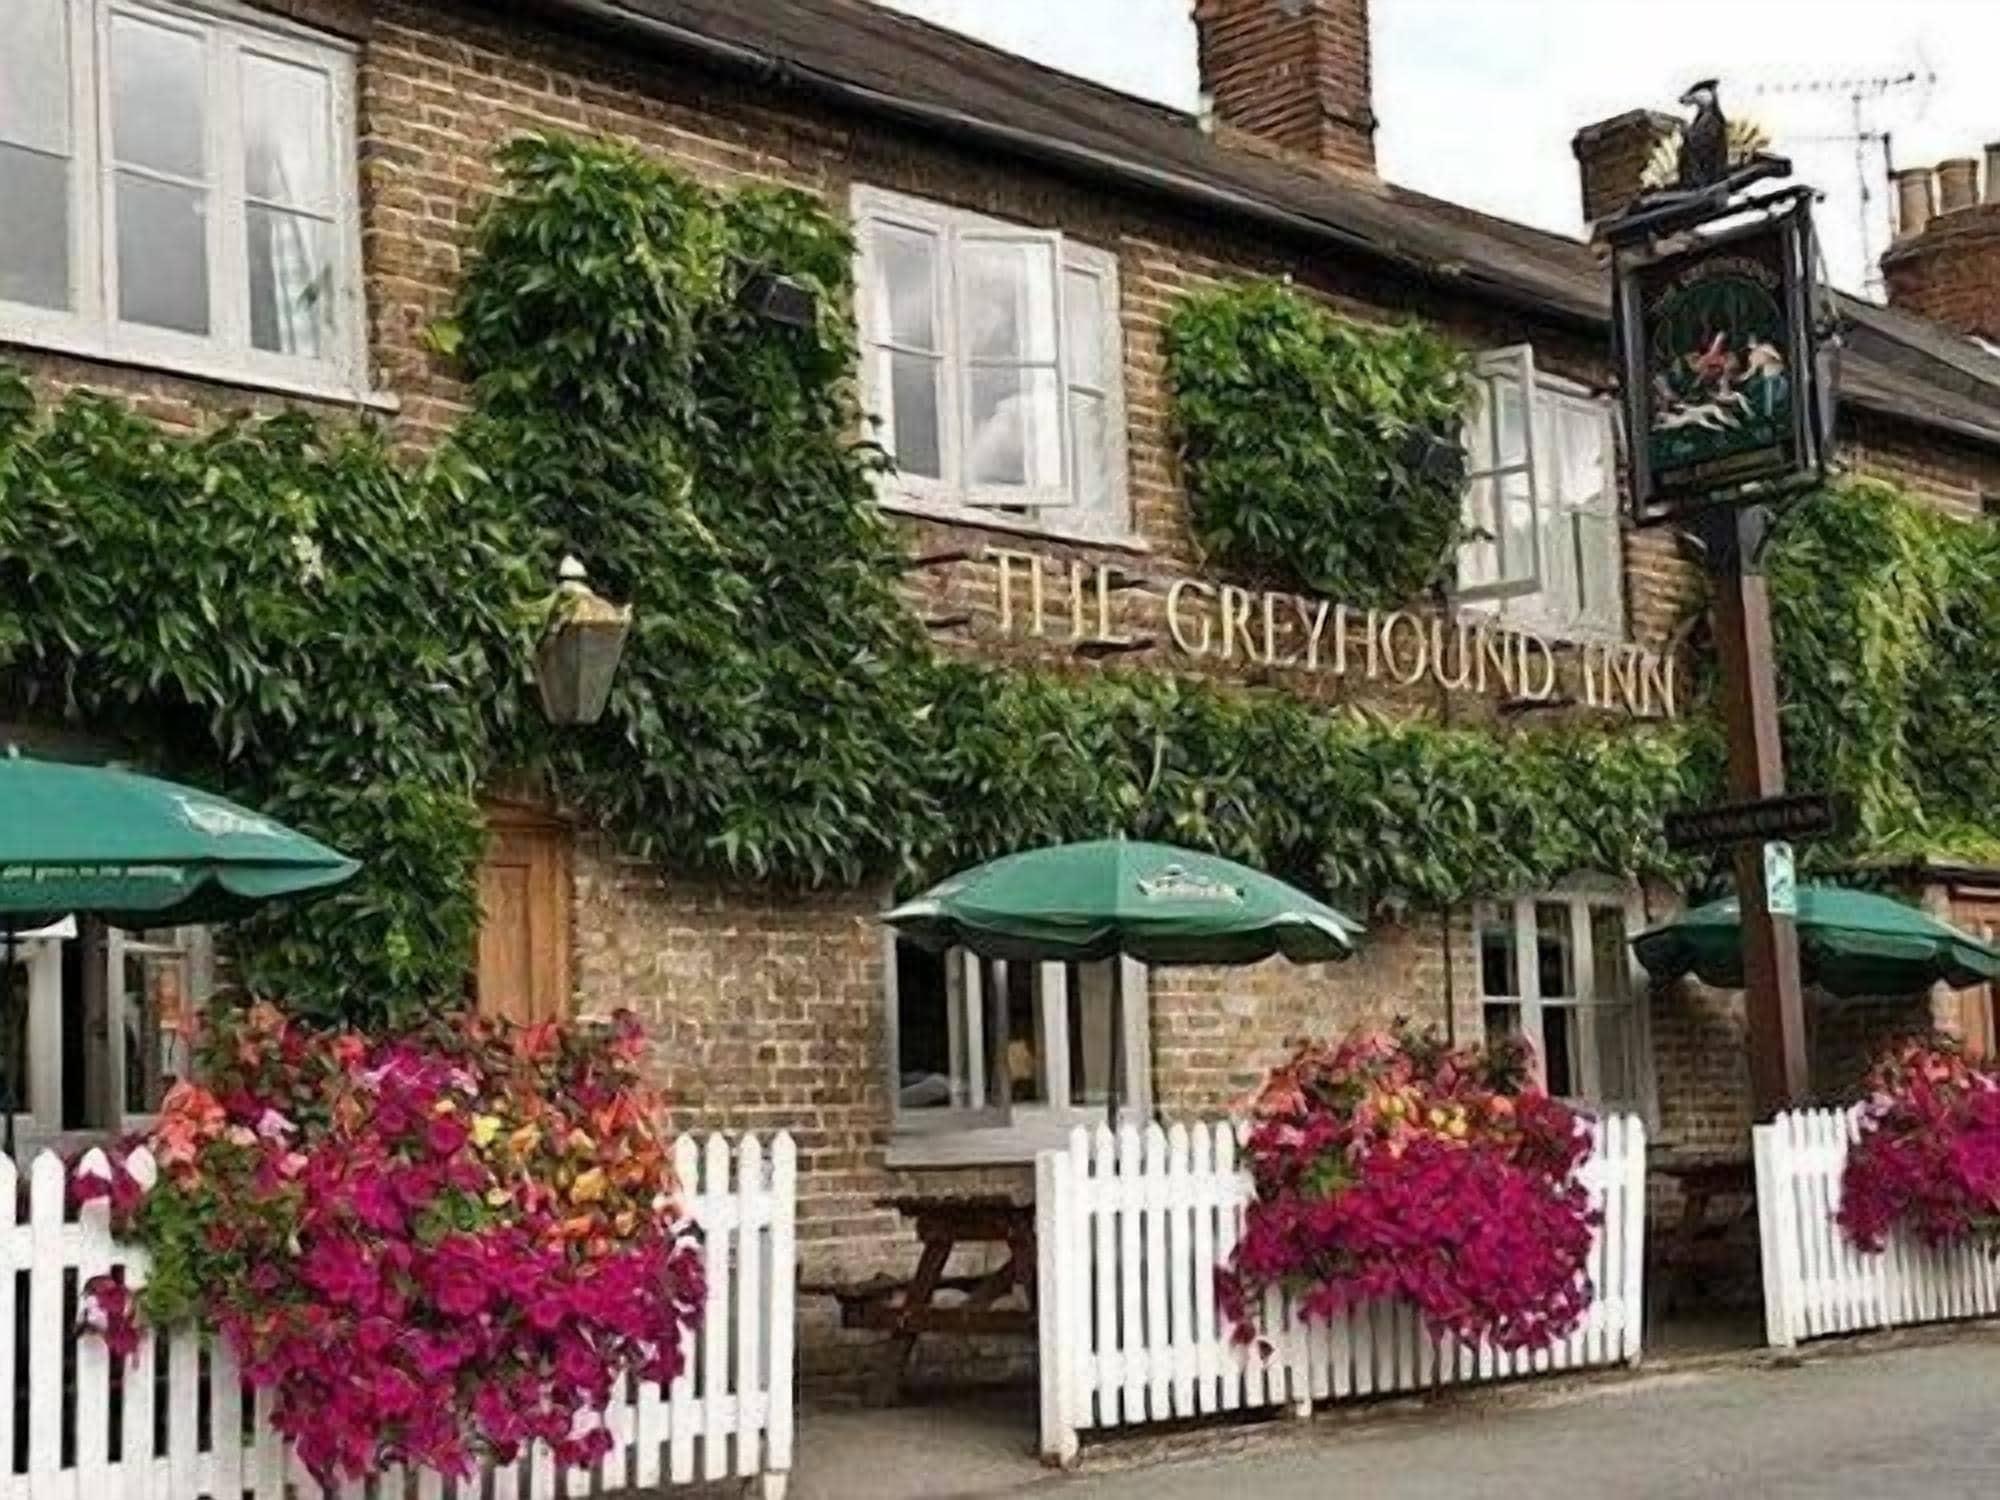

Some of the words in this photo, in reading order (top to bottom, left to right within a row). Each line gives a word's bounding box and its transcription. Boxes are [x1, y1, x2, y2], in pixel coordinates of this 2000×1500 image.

[984, 545, 1133, 643] THE
[1168, 579, 1555, 700] GREYHOUND
[1583, 644, 1676, 720] INN
